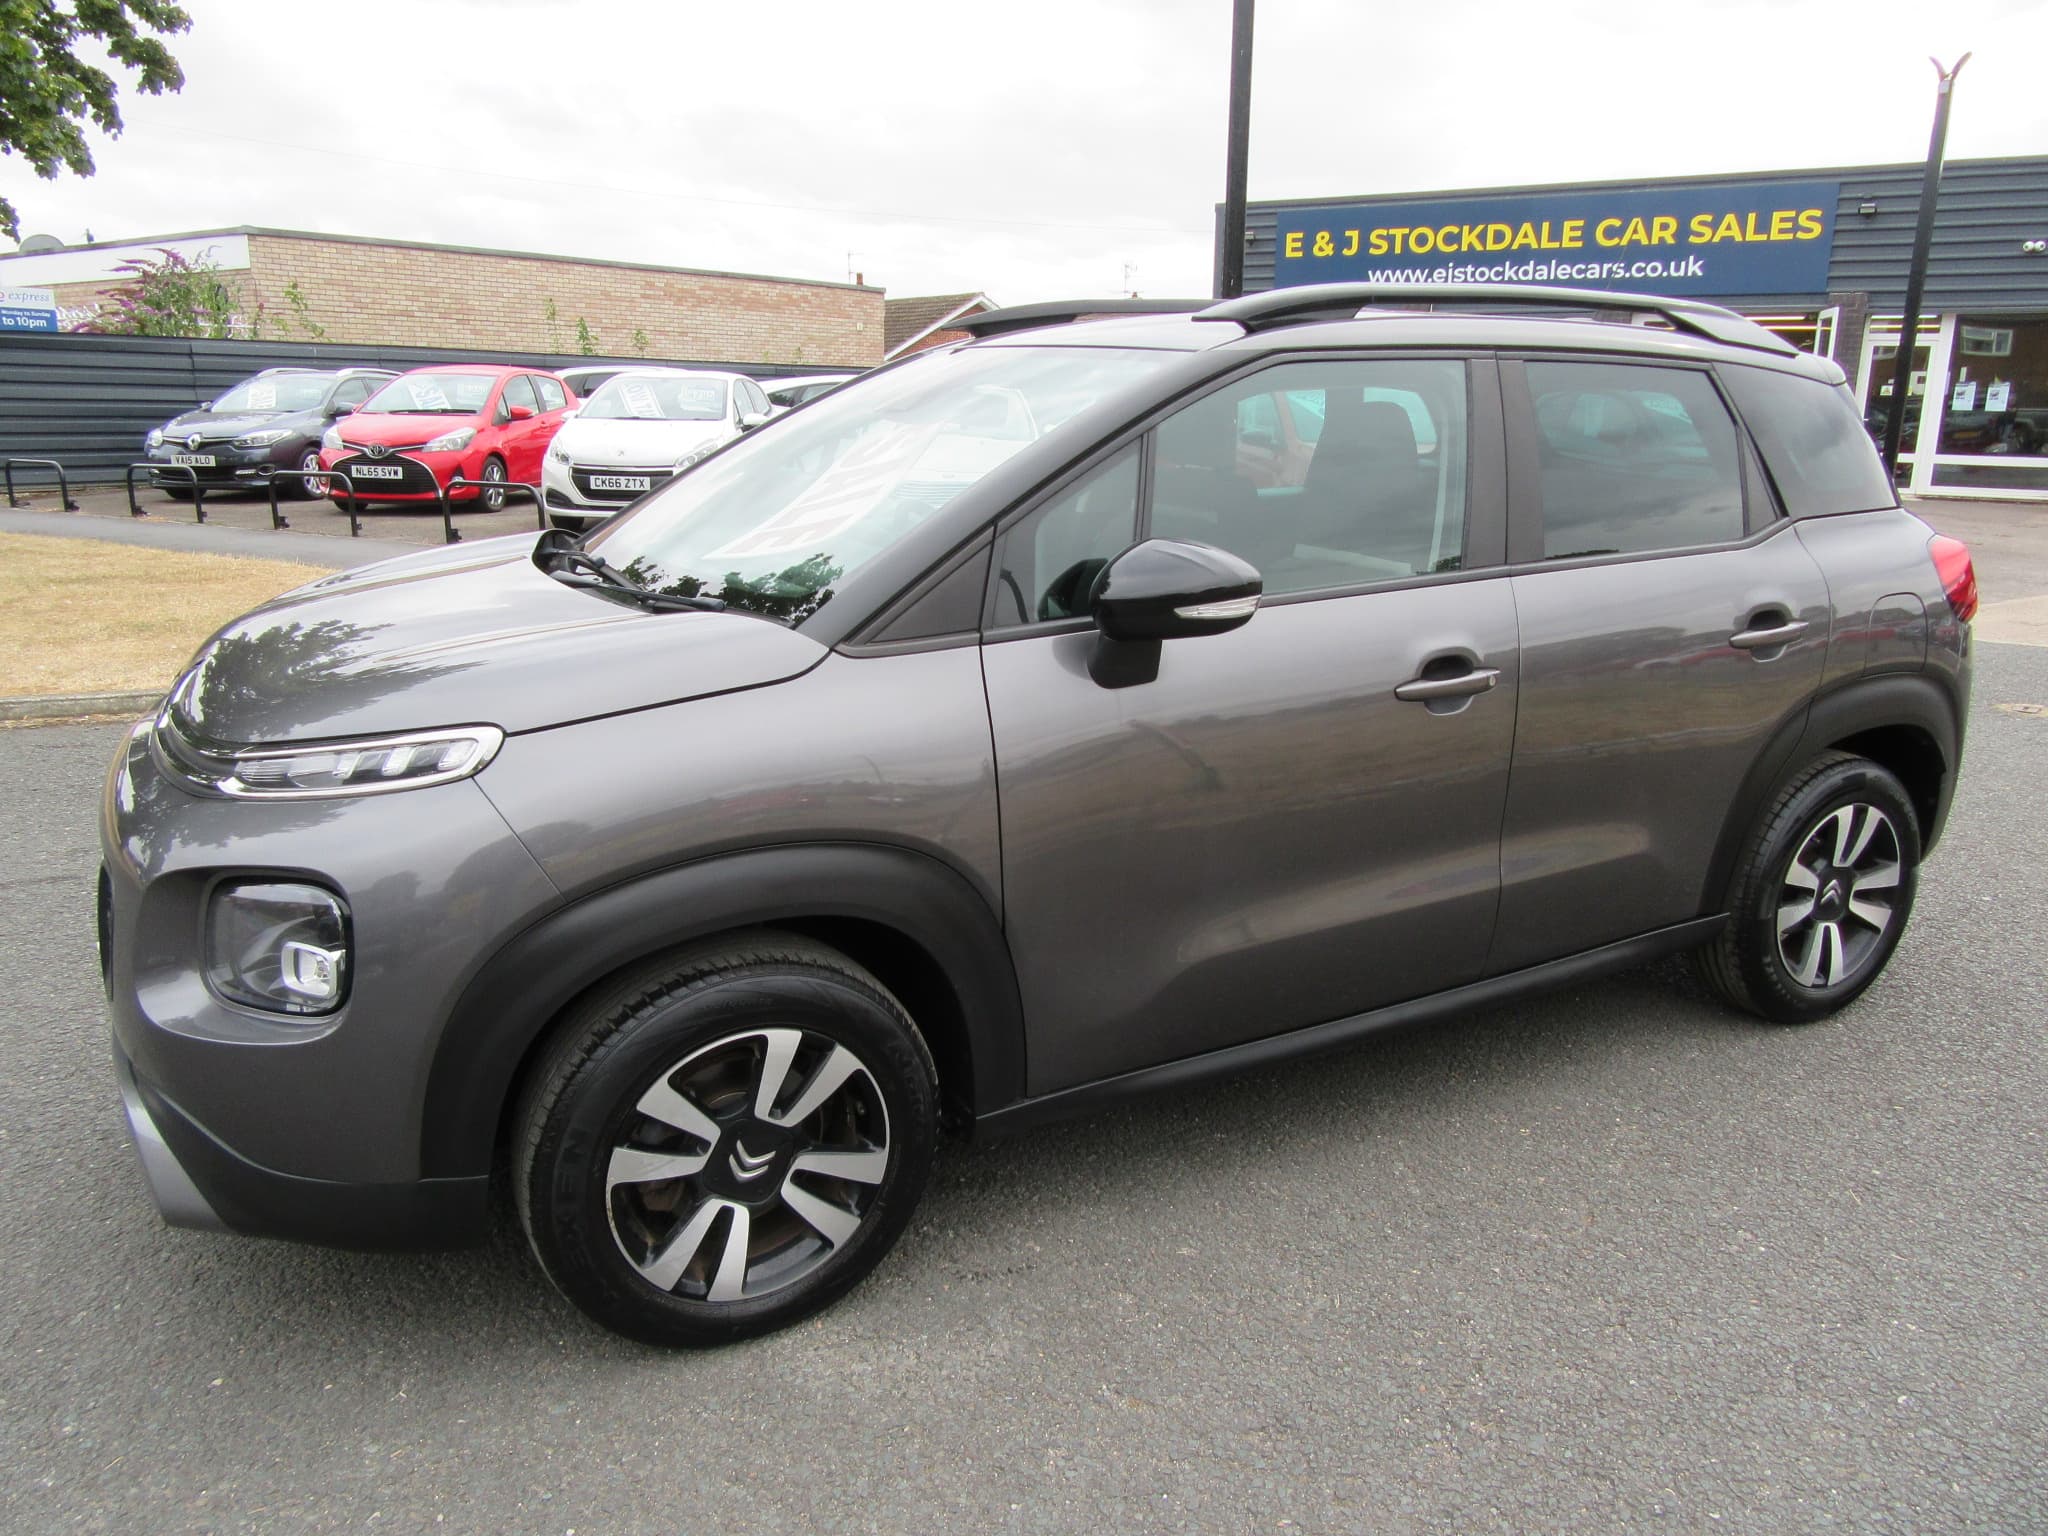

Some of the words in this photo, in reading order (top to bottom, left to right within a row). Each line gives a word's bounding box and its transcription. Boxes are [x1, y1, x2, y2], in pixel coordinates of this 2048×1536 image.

[1284, 231, 1304, 258] E
[1312, 230, 1335, 257] &
[1342, 229, 1360, 256] J
[1367, 219, 1585, 255] STOCKDALE
[1595, 216, 1678, 247] CAR
[1687, 208, 1823, 245] SALES
[2, 316, 15, 326] to
[16, 316, 48, 329] 10pm
[355, 466, 379, 477] NL65
[594, 477, 622, 488] CK66
[624, 478, 646, 489] ZTX
